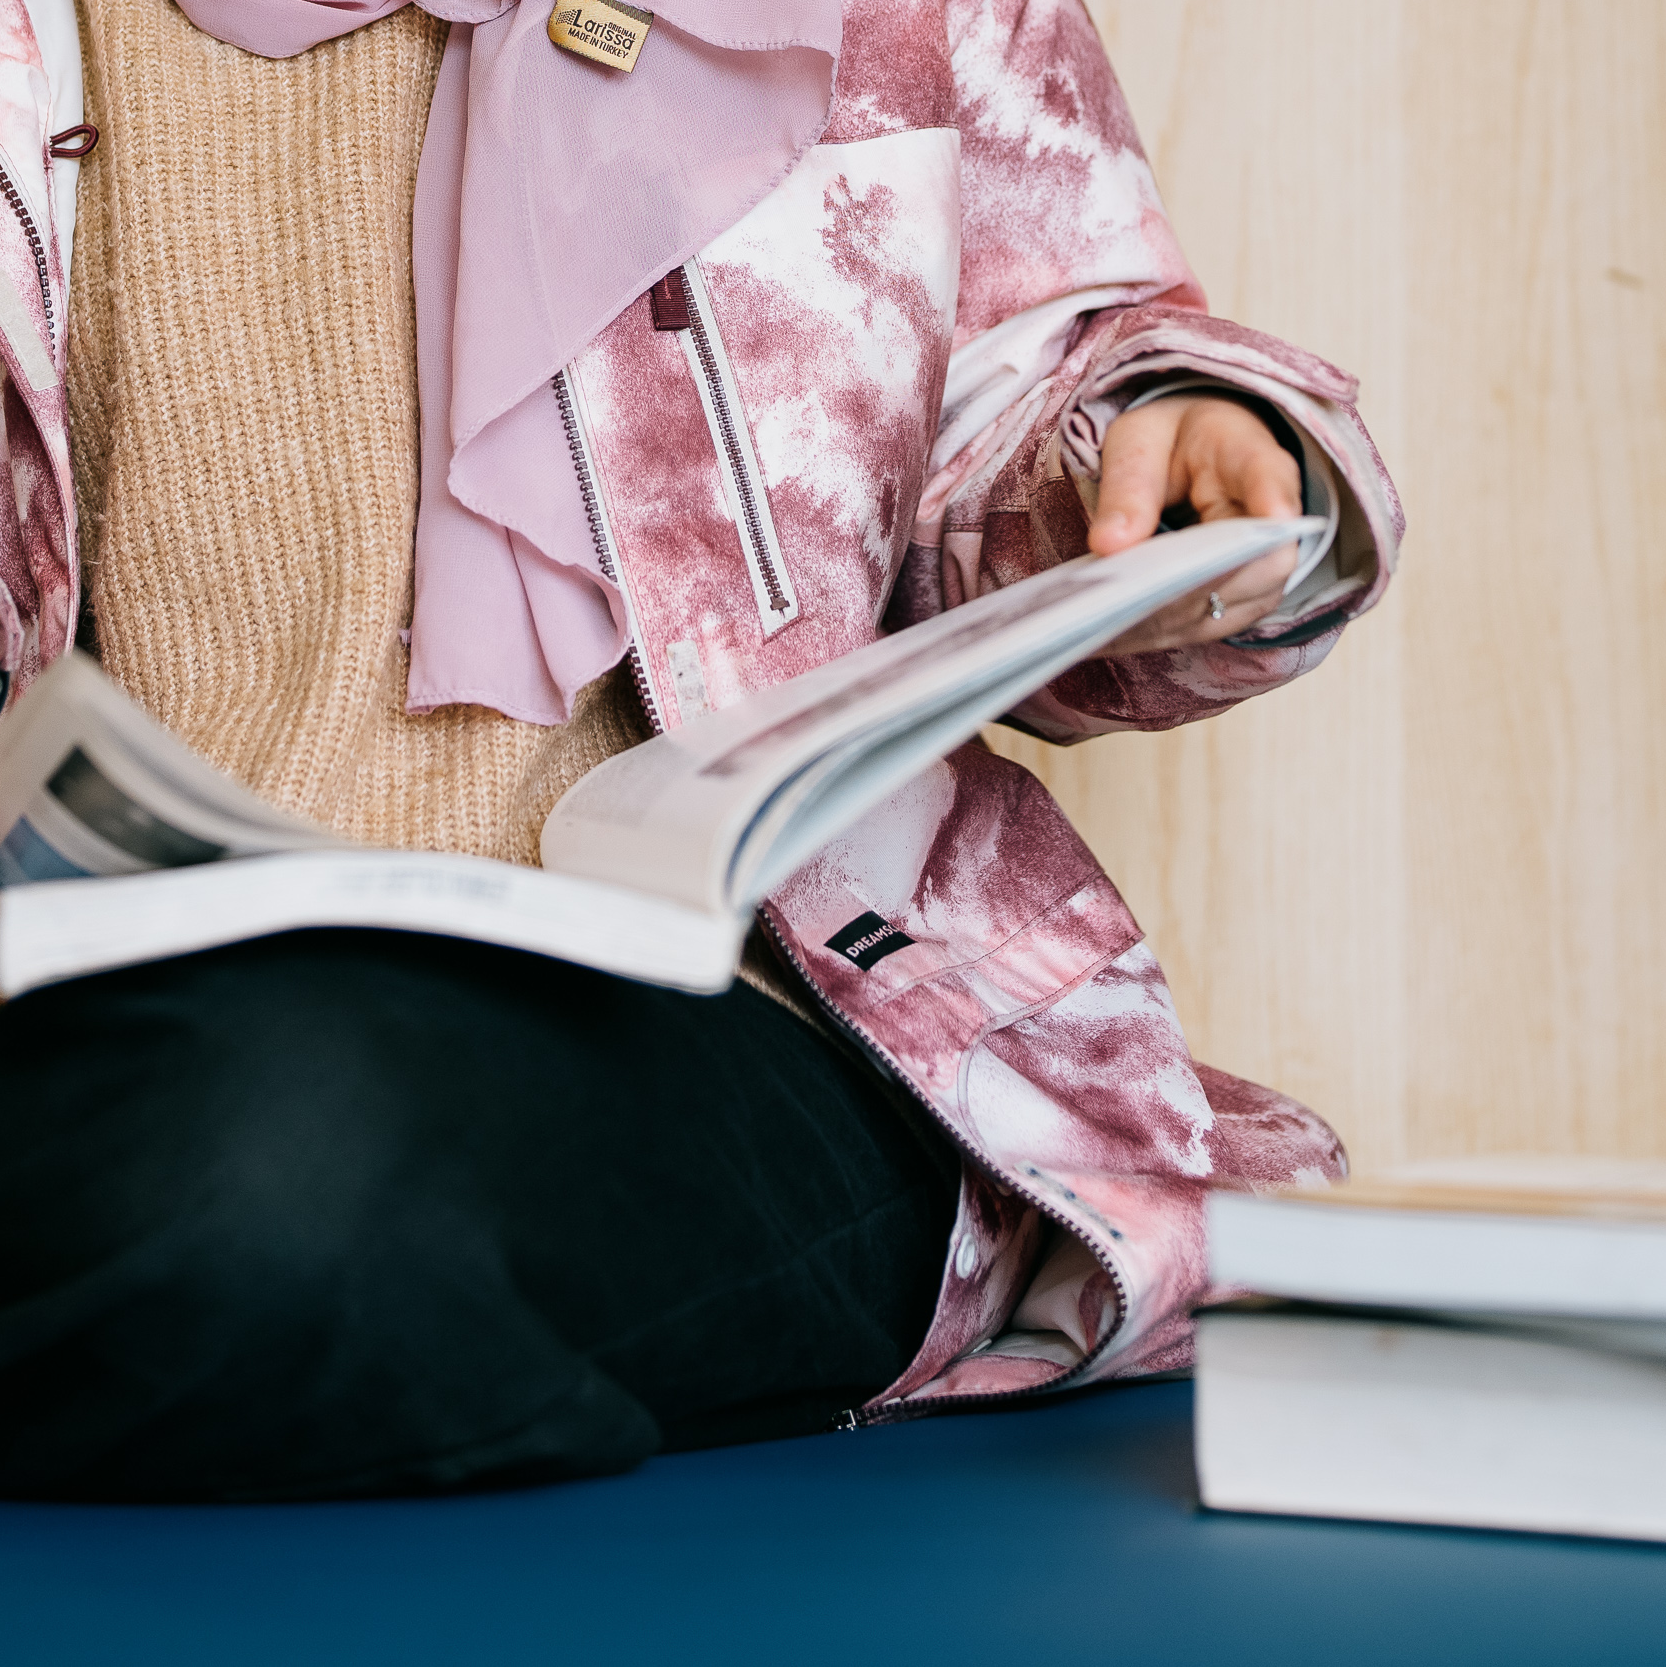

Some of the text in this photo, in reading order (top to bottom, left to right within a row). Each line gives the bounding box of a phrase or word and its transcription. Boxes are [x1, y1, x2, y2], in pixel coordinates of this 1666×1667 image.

[567, 27, 629, 59] MADE IN TURKEY
[572, 9, 636, 51] Larissa
[607, 21, 637, 40] ORIGINAL
